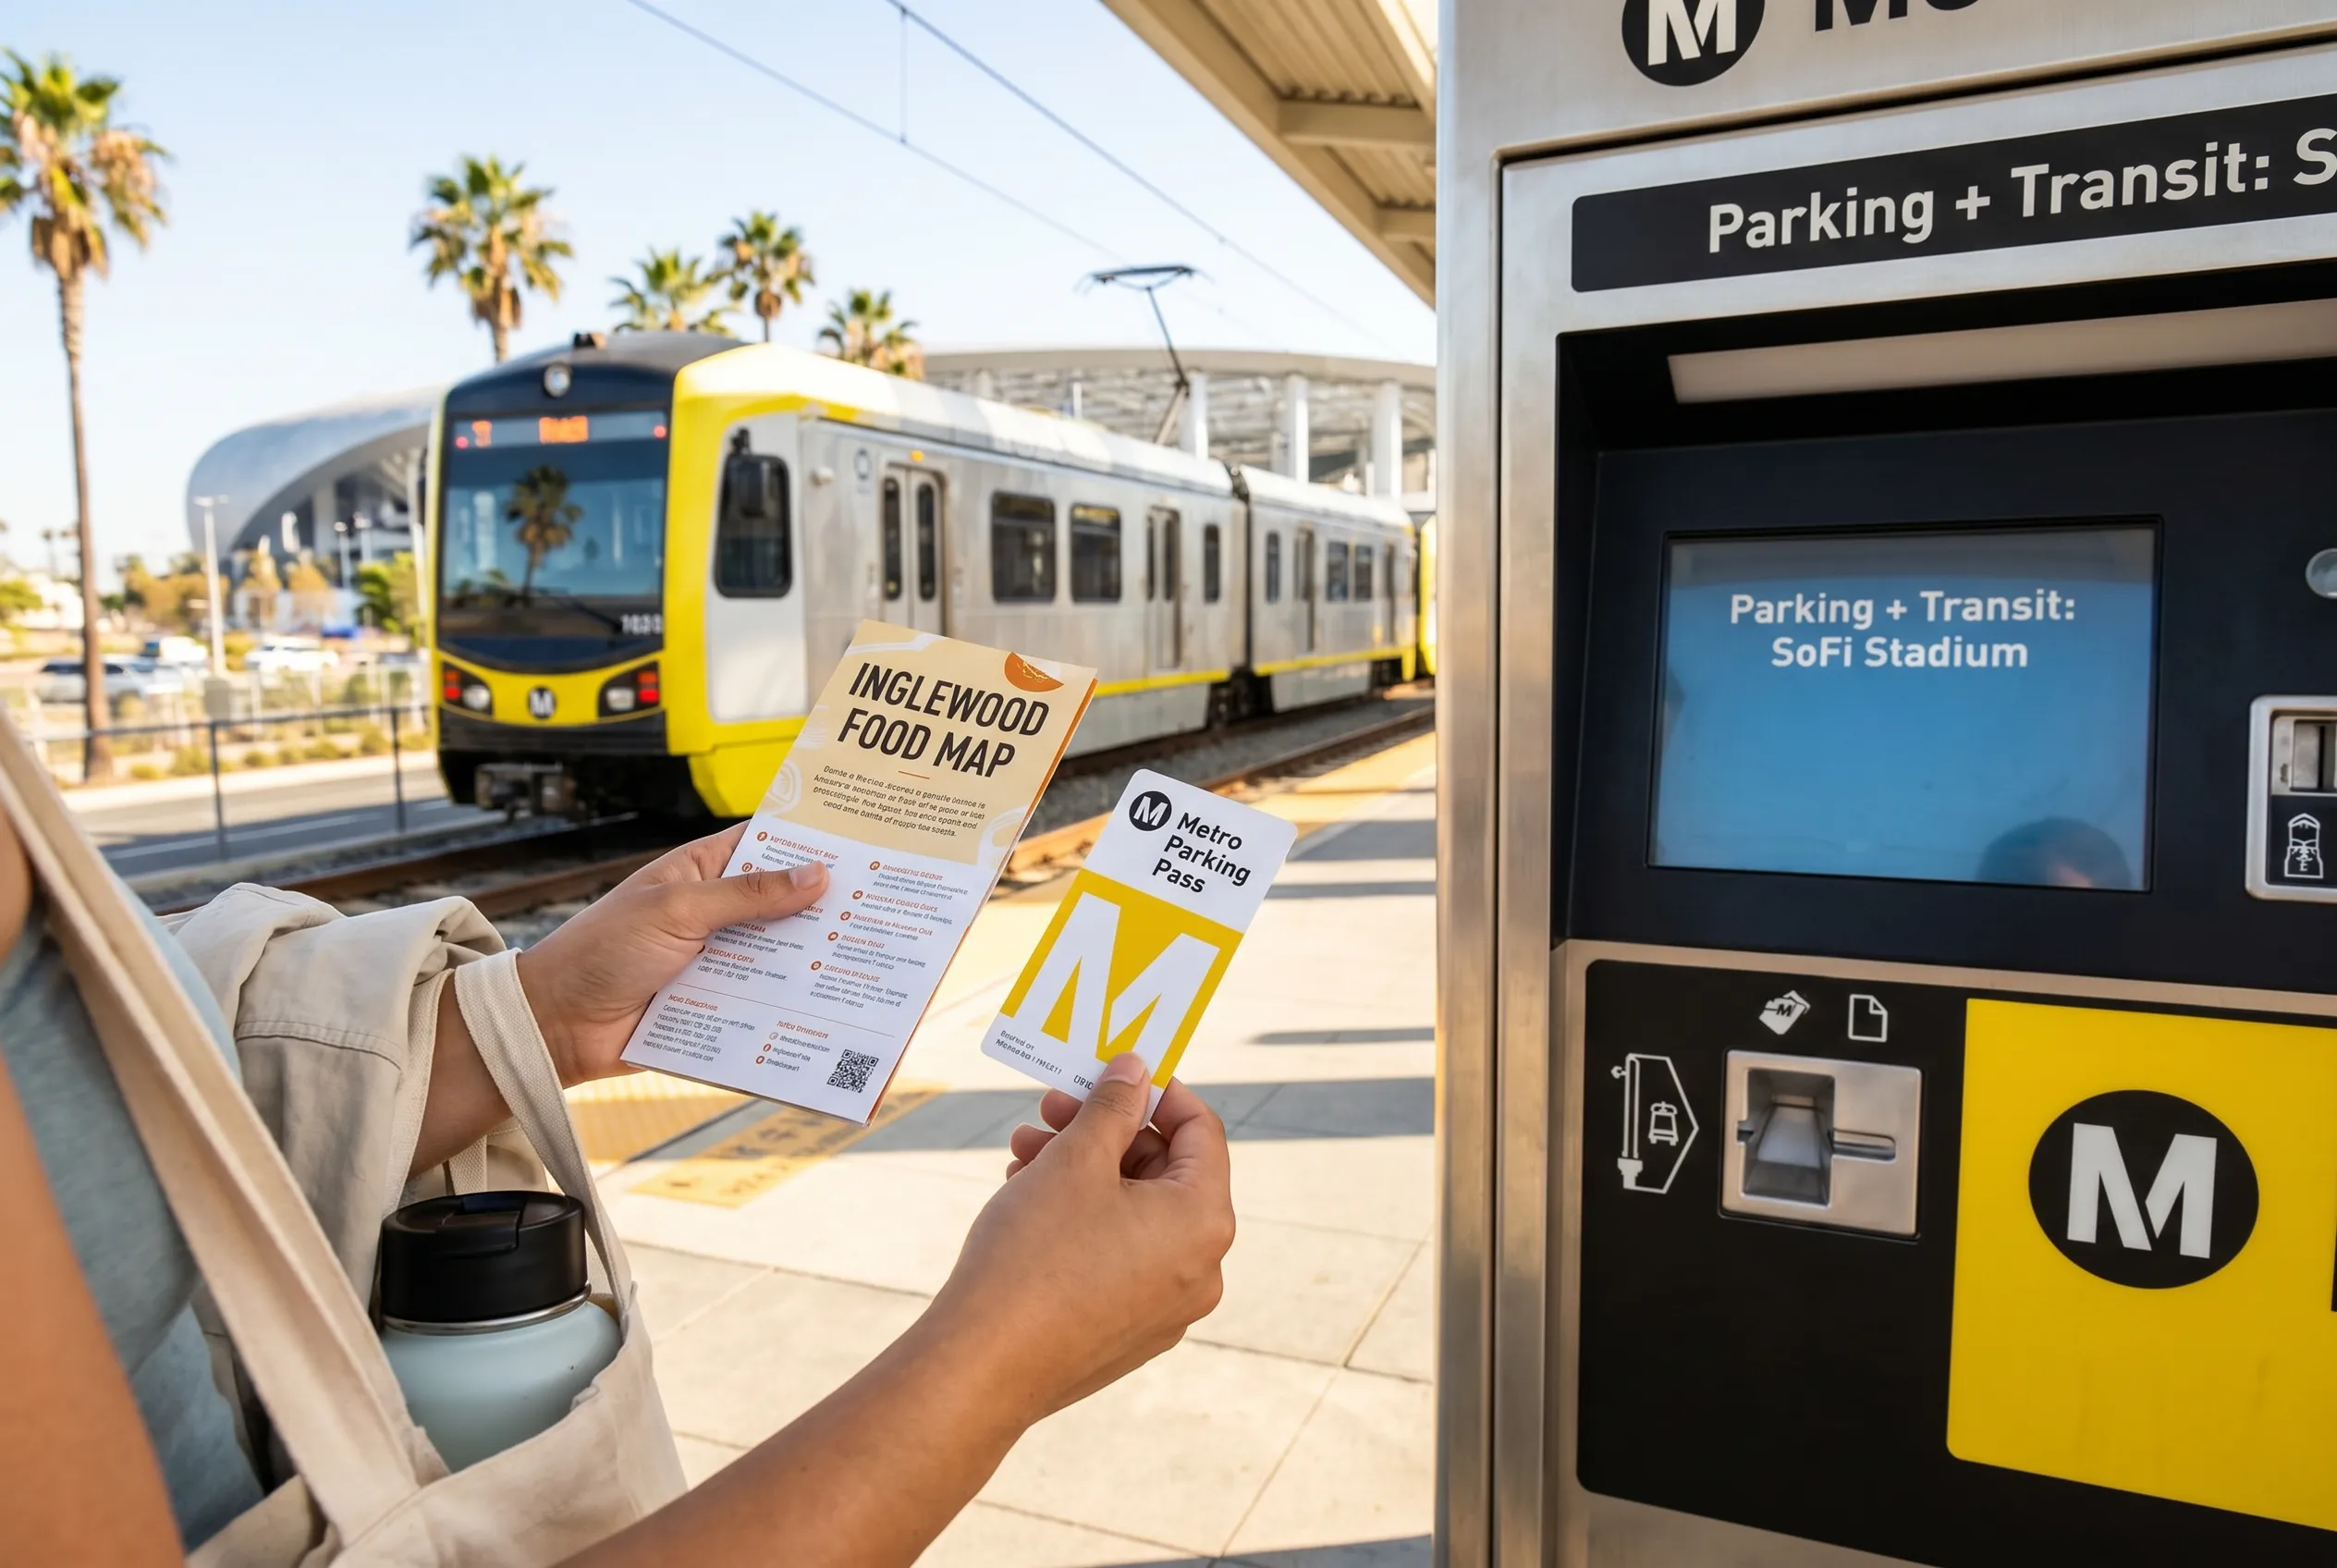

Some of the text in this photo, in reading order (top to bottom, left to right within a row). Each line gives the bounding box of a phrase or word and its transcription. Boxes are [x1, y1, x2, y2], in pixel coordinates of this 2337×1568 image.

[1647, 0, 1737, 67] M
[1707, 185, 1934, 253] Parking
[2010, 141, 2270, 218] Transit:
[1730, 591, 1874, 630] Parking
[1919, 589, 2076, 622] Transit:
[1770, 634, 2029, 668] SoFi Stadium
[849, 662, 1049, 736] INGLEWOOD
[838, 707, 1017, 778] FOOD MAP
[1133, 795, 1242, 851] M Metro
[1151, 857, 1206, 894] Pass
[1163, 835, 1252, 888] Parking
[2066, 1122, 2218, 1259] M
